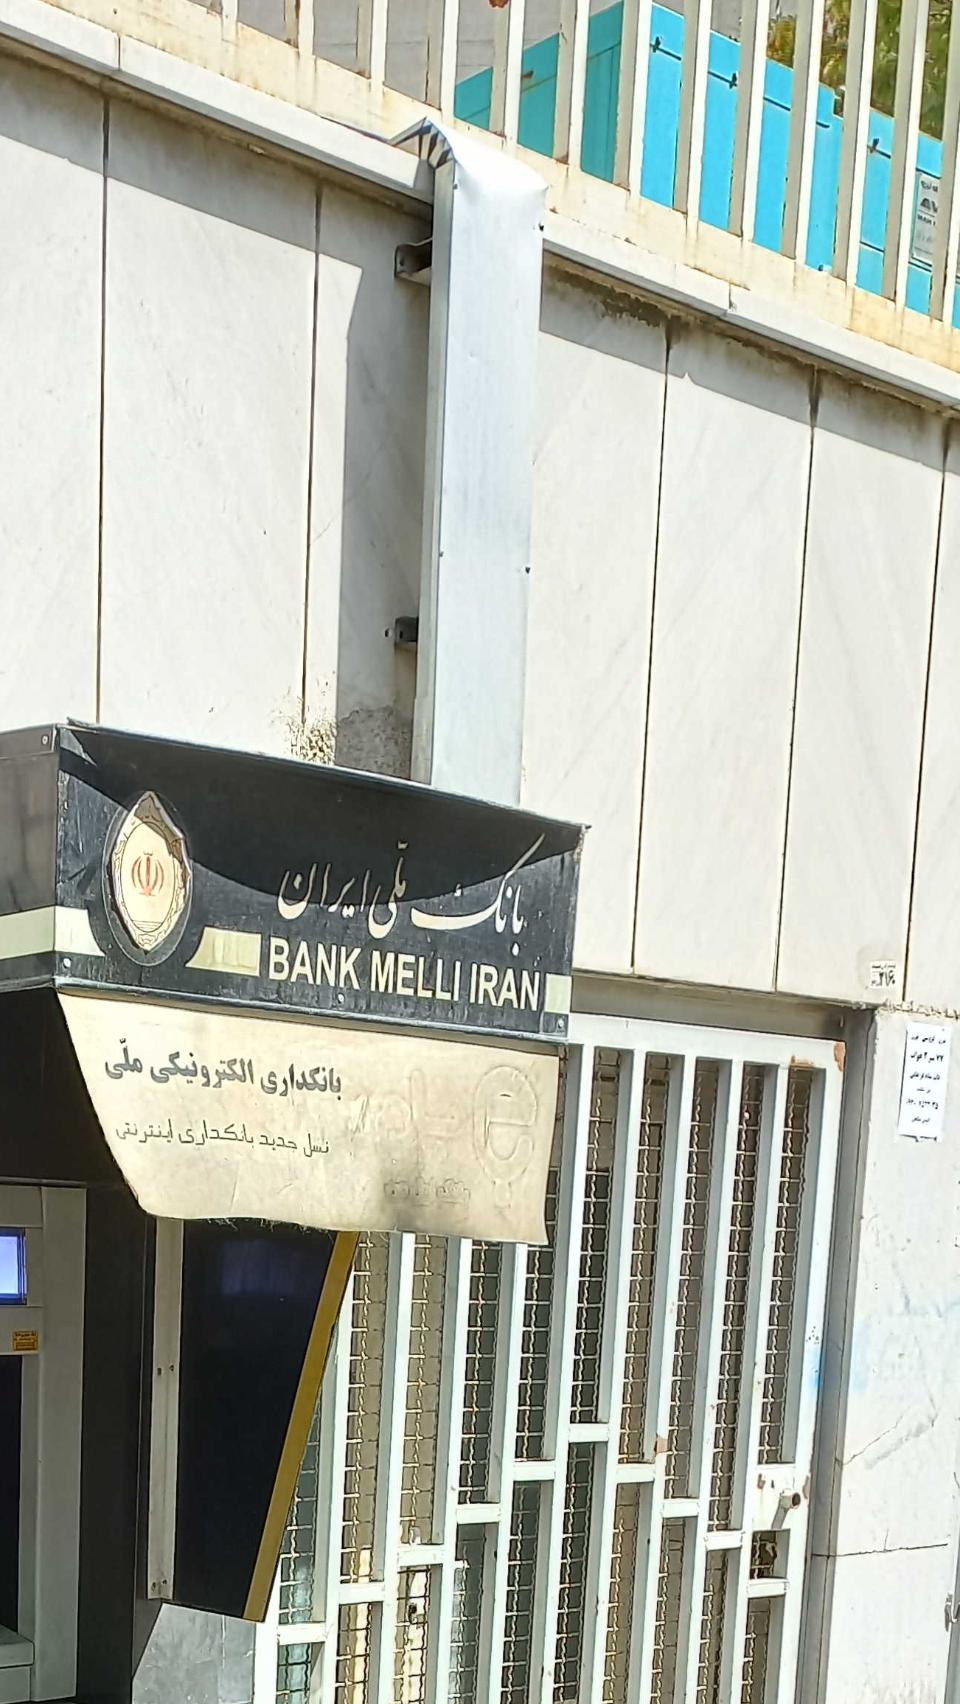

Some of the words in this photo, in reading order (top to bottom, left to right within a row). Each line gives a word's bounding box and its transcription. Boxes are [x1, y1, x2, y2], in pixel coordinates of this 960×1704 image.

[276, 861, 371, 921] ایران
[410, 832, 546, 957] بانک
[269, 936, 361, 991] BANK
[370, 949, 461, 1003] MELLI
[469, 962, 540, 1013] IRAN
[150, 1051, 255, 1089] الکترونیکی
[260, 1064, 342, 1101] بانکداری
[115, 1118, 174, 1143] اینترنتی
[178, 1119, 254, 1149] بانکداری
[303, 1133, 330, 1158] نسل
